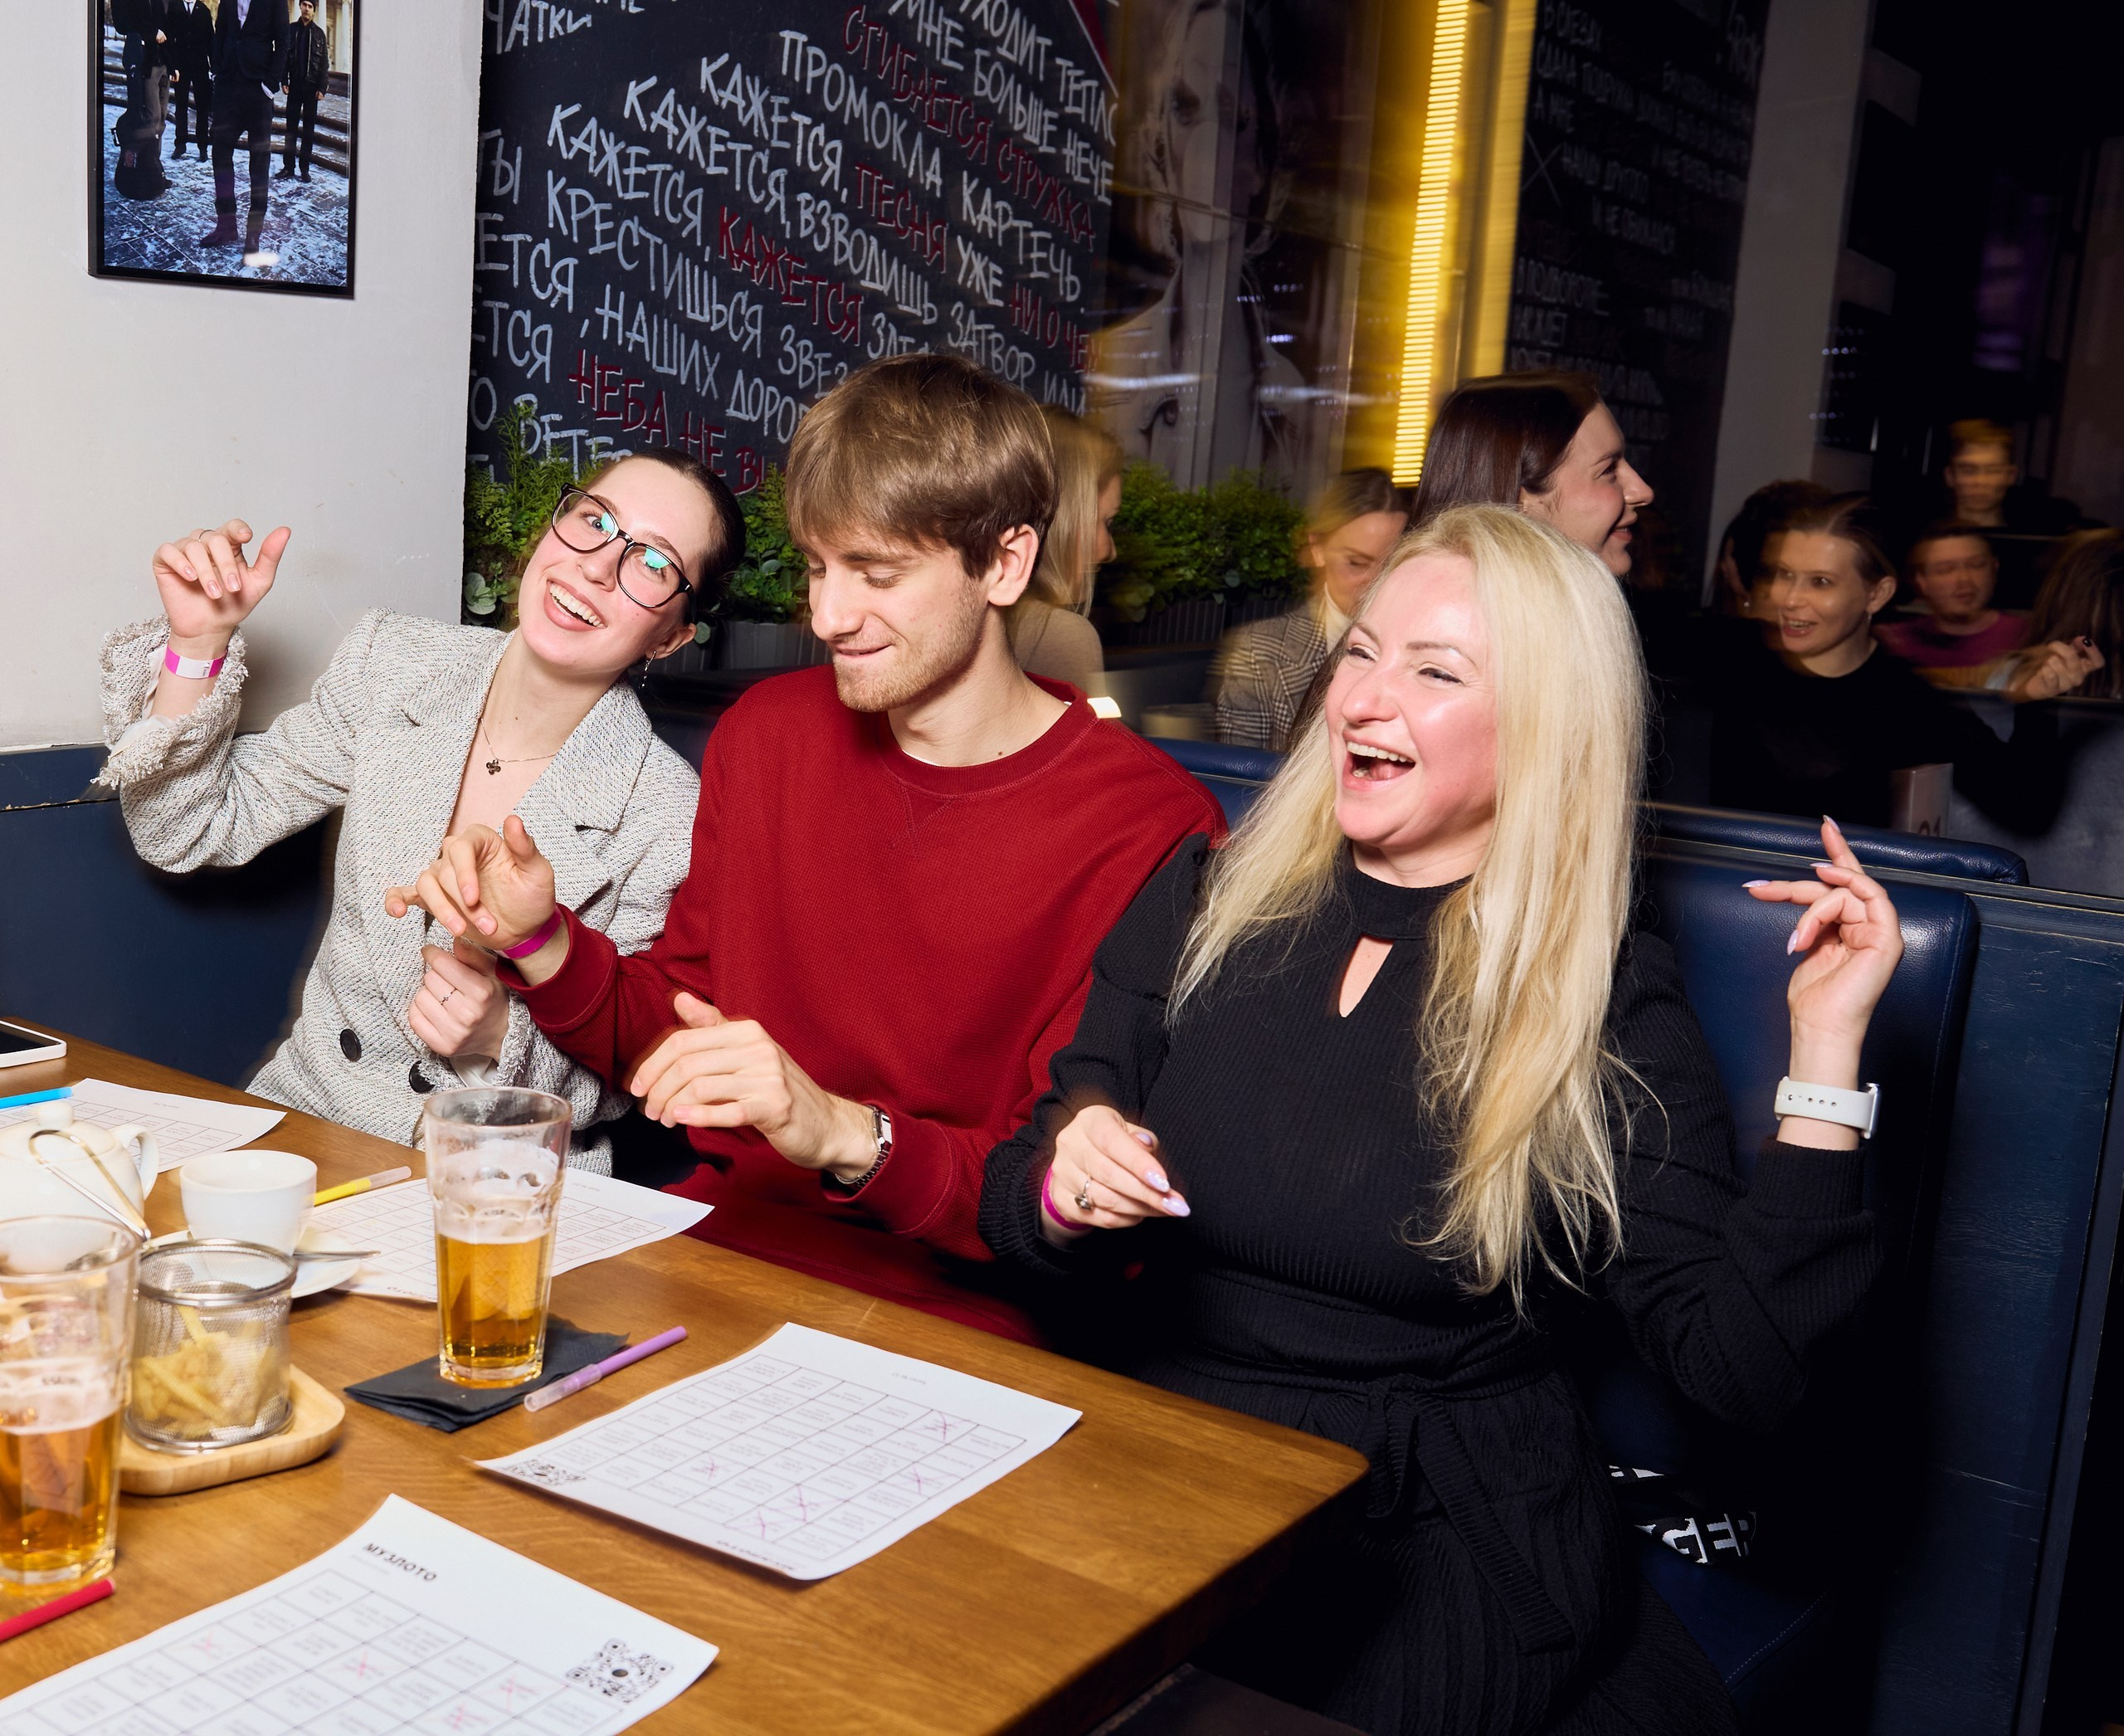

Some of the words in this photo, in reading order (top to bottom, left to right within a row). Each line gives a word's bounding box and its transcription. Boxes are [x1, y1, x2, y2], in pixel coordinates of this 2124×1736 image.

[700, 53, 847, 203] КАЖЕТСЯ,
[855, 162, 949, 274] ПЕСНЯ
[957, 235, 1004, 307] УЖЕ
[1009, 278, 1041, 340] НИ
[1045, 305, 1060, 349] О
[779, 30, 942, 197] ПРОМОКЛА
[843, 5, 993, 164] СГИБАЕТСЯ
[997, 138, 1096, 251] СТРУЖКА
[974, 48, 1059, 153] БОЛЬШЕ
[1062, 129, 1113, 206] НЕЧЕ
[547, 103, 710, 261] КАЖЕТСЯ,
[719, 205, 865, 346] КАЖЕТСЯ
[548, 170, 763, 358] КРЕСТИШЬСЯ
[624, 76, 791, 238] КАЖЕТСЯ,
[948, 301, 1035, 393] ЗАТВОР
[568, 349, 670, 448] НЕБА
[679, 412, 727, 477] НЕ
[595, 284, 720, 400] НАШИХ
[363, 1543, 437, 1582] МУЗЛОТО
